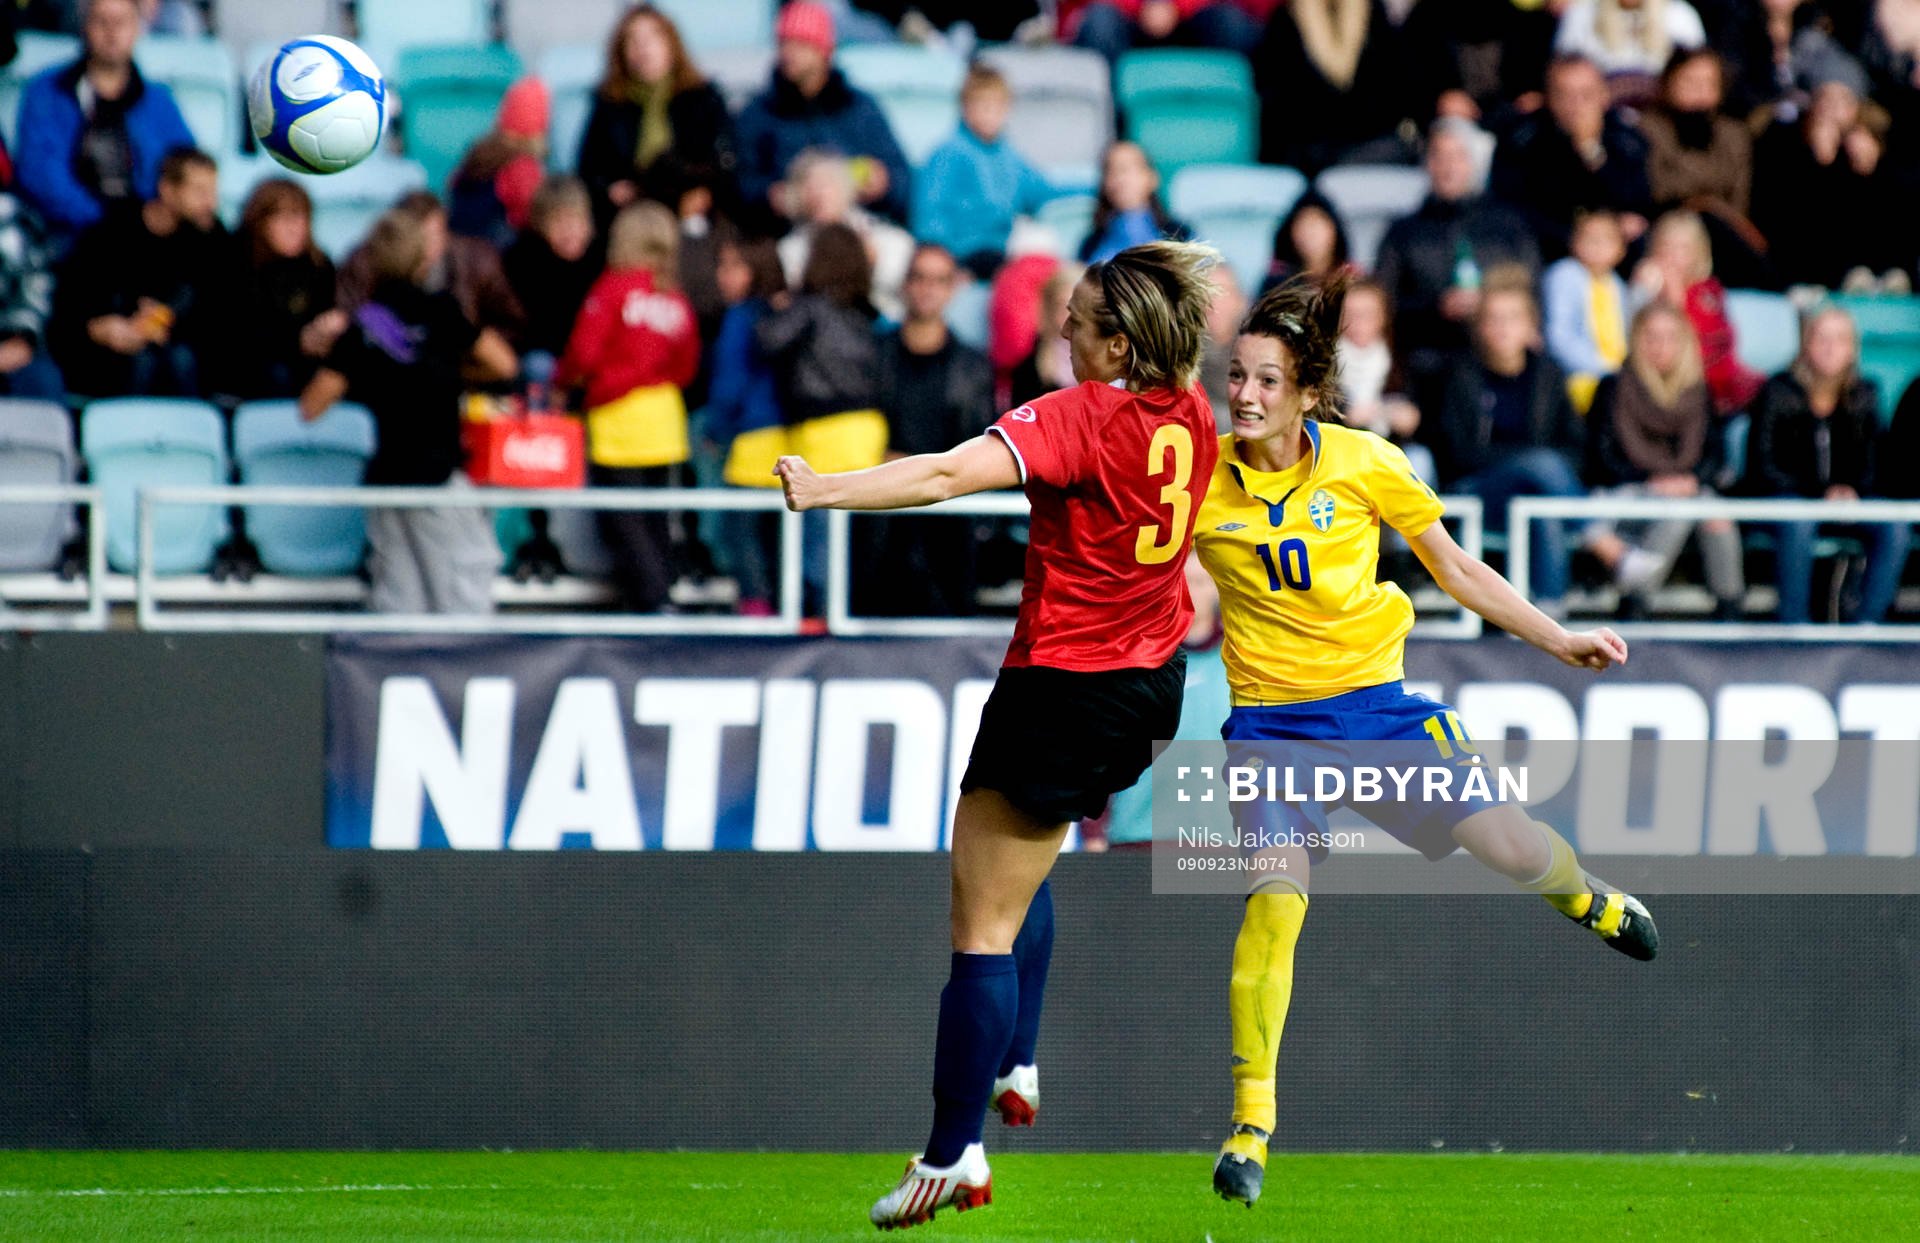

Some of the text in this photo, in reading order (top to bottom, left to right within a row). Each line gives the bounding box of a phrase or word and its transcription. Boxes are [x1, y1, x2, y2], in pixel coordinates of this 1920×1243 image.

[1135, 424, 1194, 565] 3
[1256, 538, 1311, 591] 10
[1330, 681, 1920, 856] PORT
